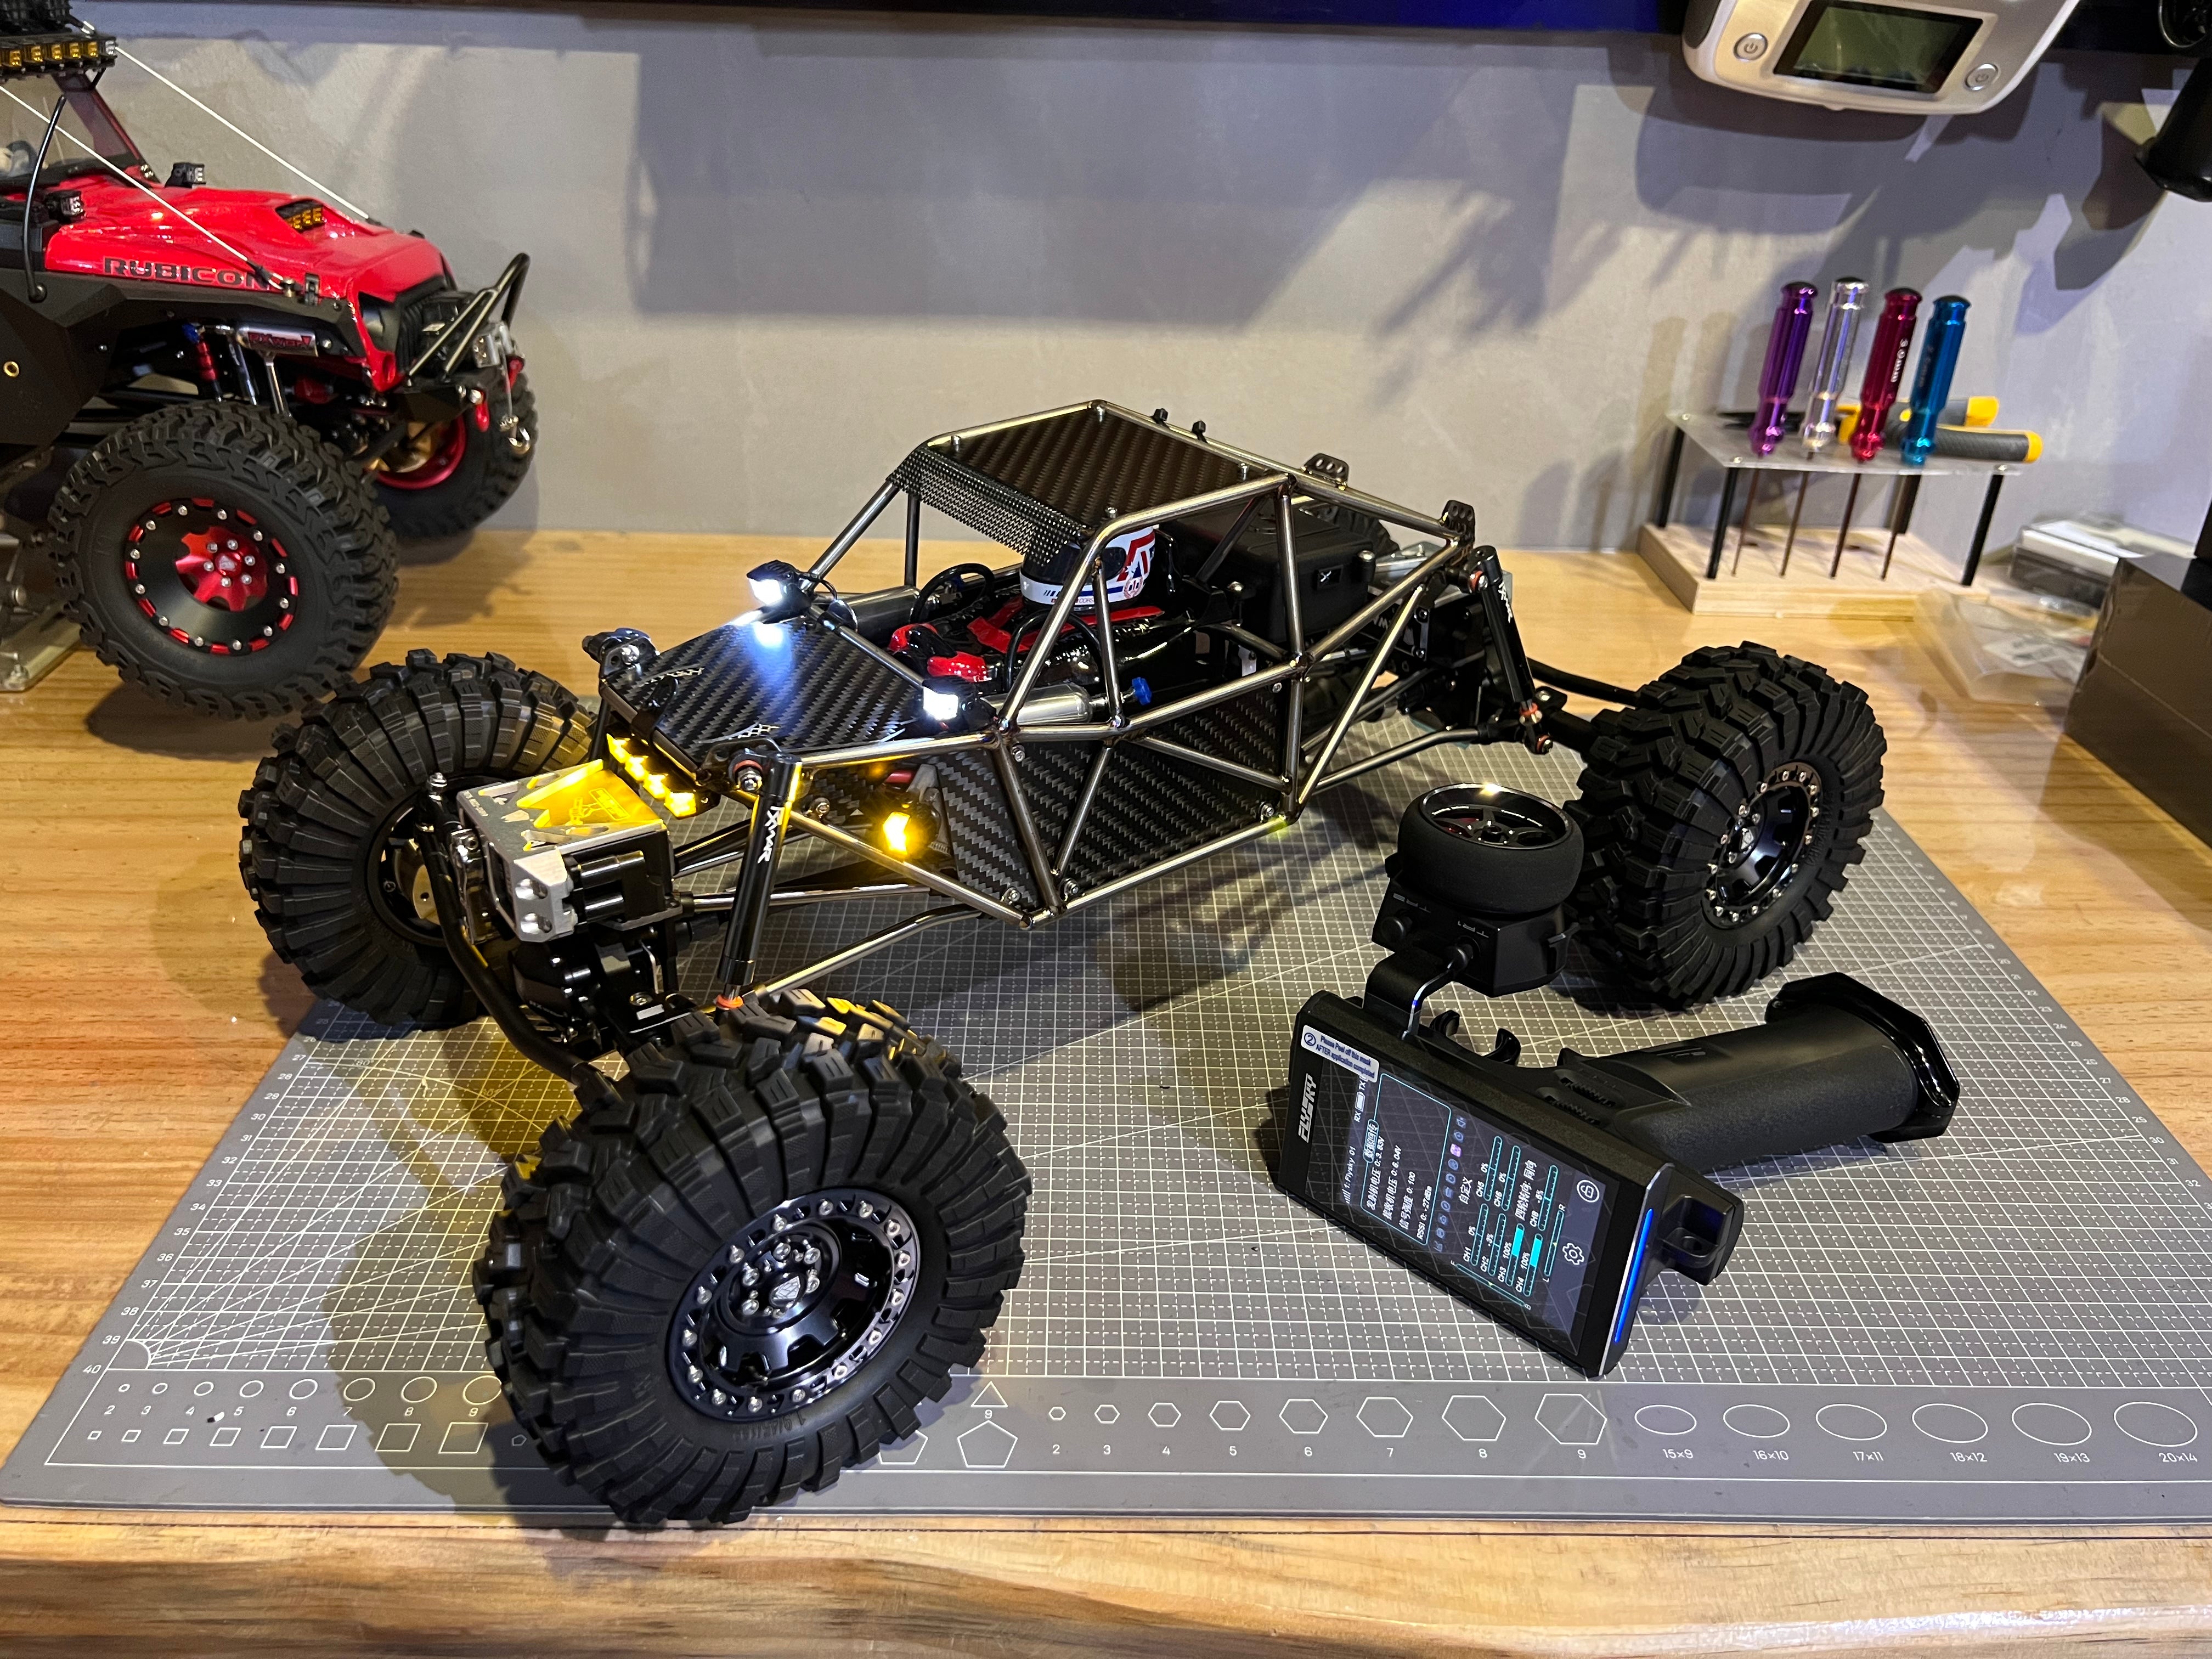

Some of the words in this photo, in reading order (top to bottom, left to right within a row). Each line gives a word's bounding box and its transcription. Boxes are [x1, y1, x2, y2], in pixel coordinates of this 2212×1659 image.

[104, 257, 270, 291] RUBICON
[1458, 920, 1489, 939] TR1
[1316, 1044, 1331, 1057] AFTER
[1358, 1082, 1366, 1091] TX
[1298, 1073, 1317, 1143] FLYSKY
[1354, 1111, 1361, 1122] RX
[1349, 1146, 1356, 1155] 01
[1481, 1163, 1489, 1173] 0%
[1523, 1160, 1537, 1181] 同向
[1498, 1172, 1507, 1183] 0%
[1366, 1169, 1381, 1210] 发射机电压
[1458, 1176, 1473, 1205] 自定义
[1399, 1194, 1414, 1230] 信号强度
[1559, 1204, 1566, 1212] R
[1530, 1210, 1539, 1227] CH8
[1417, 1222, 1426, 1240] RSSI
[1463, 1246, 1471, 1262] CH1
[1468, 1226, 1476, 1236] 0%
[1480, 1256, 1489, 1272] CH2
[1497, 1266, 1507, 1283] CH3
[1503, 1242, 1512, 1260] 100%
[1515, 1276, 1525, 1293] CH4
[1520, 1252, 1530, 1270] 100%
[103, 1335, 121, 1344] 39
[83, 1365, 101, 1373] 40
[104, 1405, 115, 1415] 2
[141, 1406, 151, 1414] 3
[186, 1407, 194, 1415] 4
[234, 1407, 244, 1415] 5
[286, 1407, 296, 1416] 6
[342, 1407, 352, 1416] 7
[405, 1407, 414, 1416] 8
[469, 1408, 478, 1417] 9
[985, 1409, 992, 1419] 9
[1053, 1444, 1059, 1454] 2
[1104, 1445, 1110, 1454] 3
[1163, 1446, 1170, 1455] 4
[1229, 1446, 1237, 1455] 5
[1305, 1447, 1312, 1456] 6
[1387, 1448, 1393, 1457] 7
[1479, 1449, 1487, 1458] 8
[1578, 1449, 1586, 1459] 9
[1663, 1449, 1693, 1458] 15x9
[1753, 1451, 1788, 1460] 16x10
[1853, 1452, 1883, 1461] 17x11
[1950, 1452, 1987, 1462] 18x12
[2054, 1453, 2090, 1462] 19x13
[2159, 1453, 2197, 1462] 20x14
